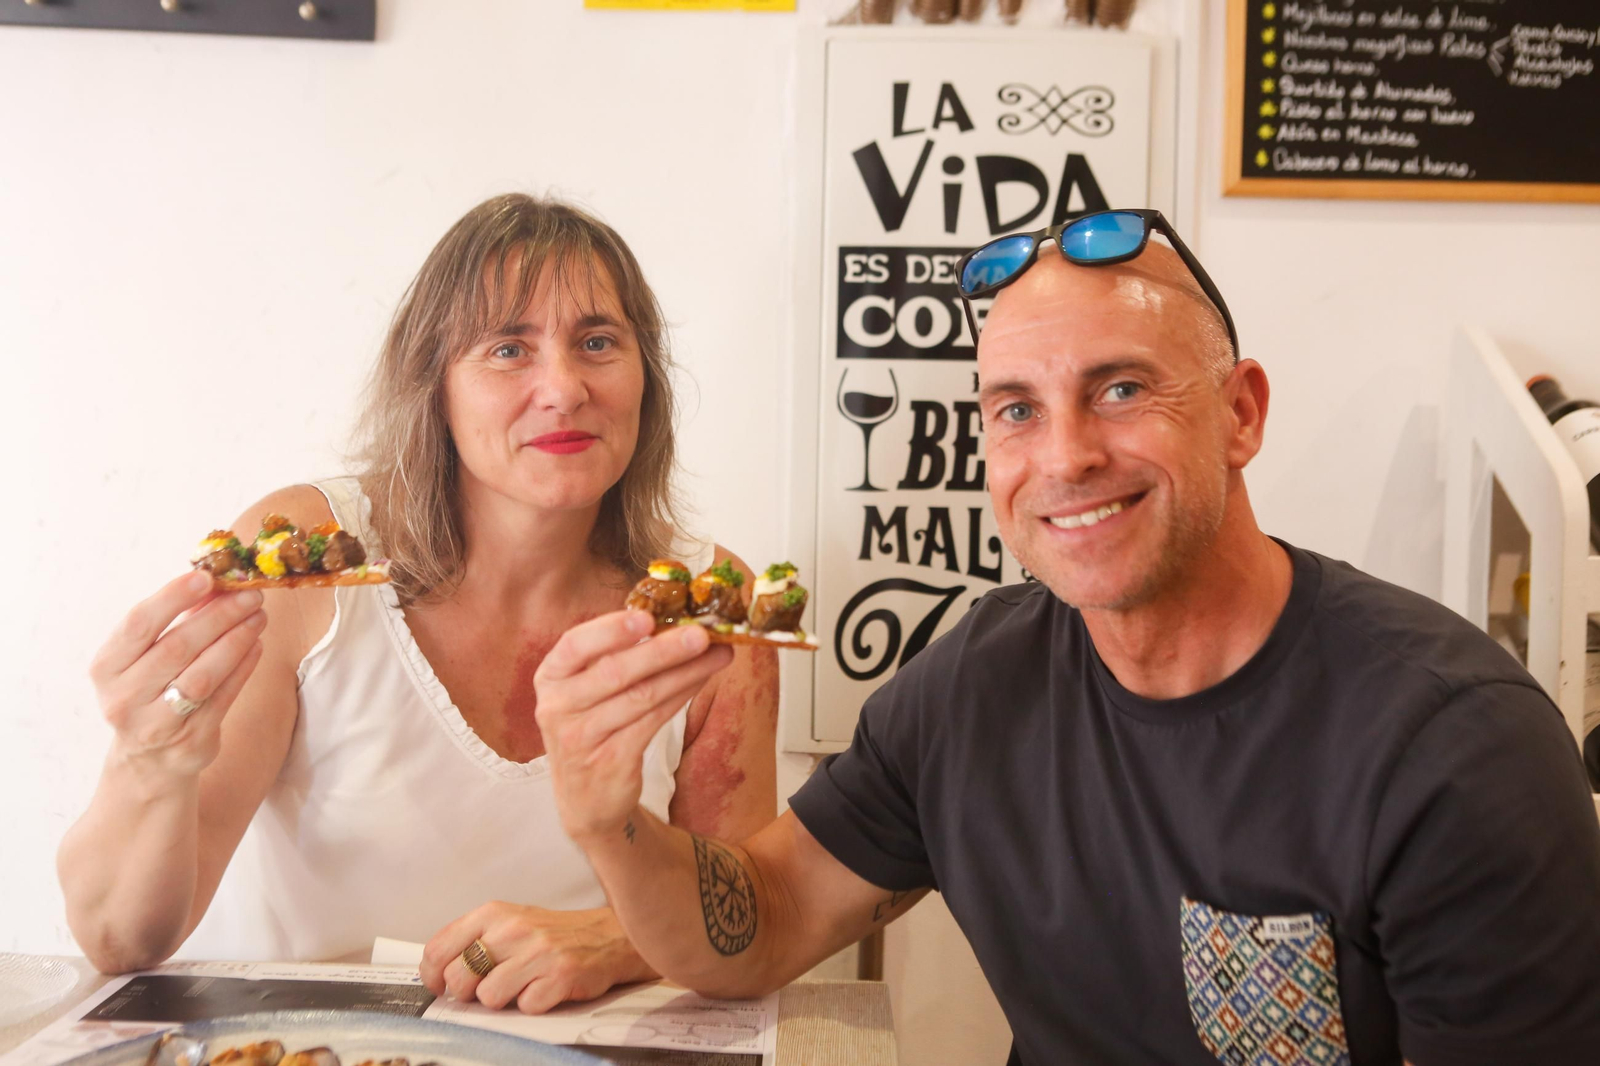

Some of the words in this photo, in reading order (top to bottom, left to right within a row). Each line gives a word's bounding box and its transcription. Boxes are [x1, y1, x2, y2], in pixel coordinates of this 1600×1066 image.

[892, 81, 975, 138] LA
[844, 253, 890, 284] ES
[858, 505, 1002, 584] MAL
